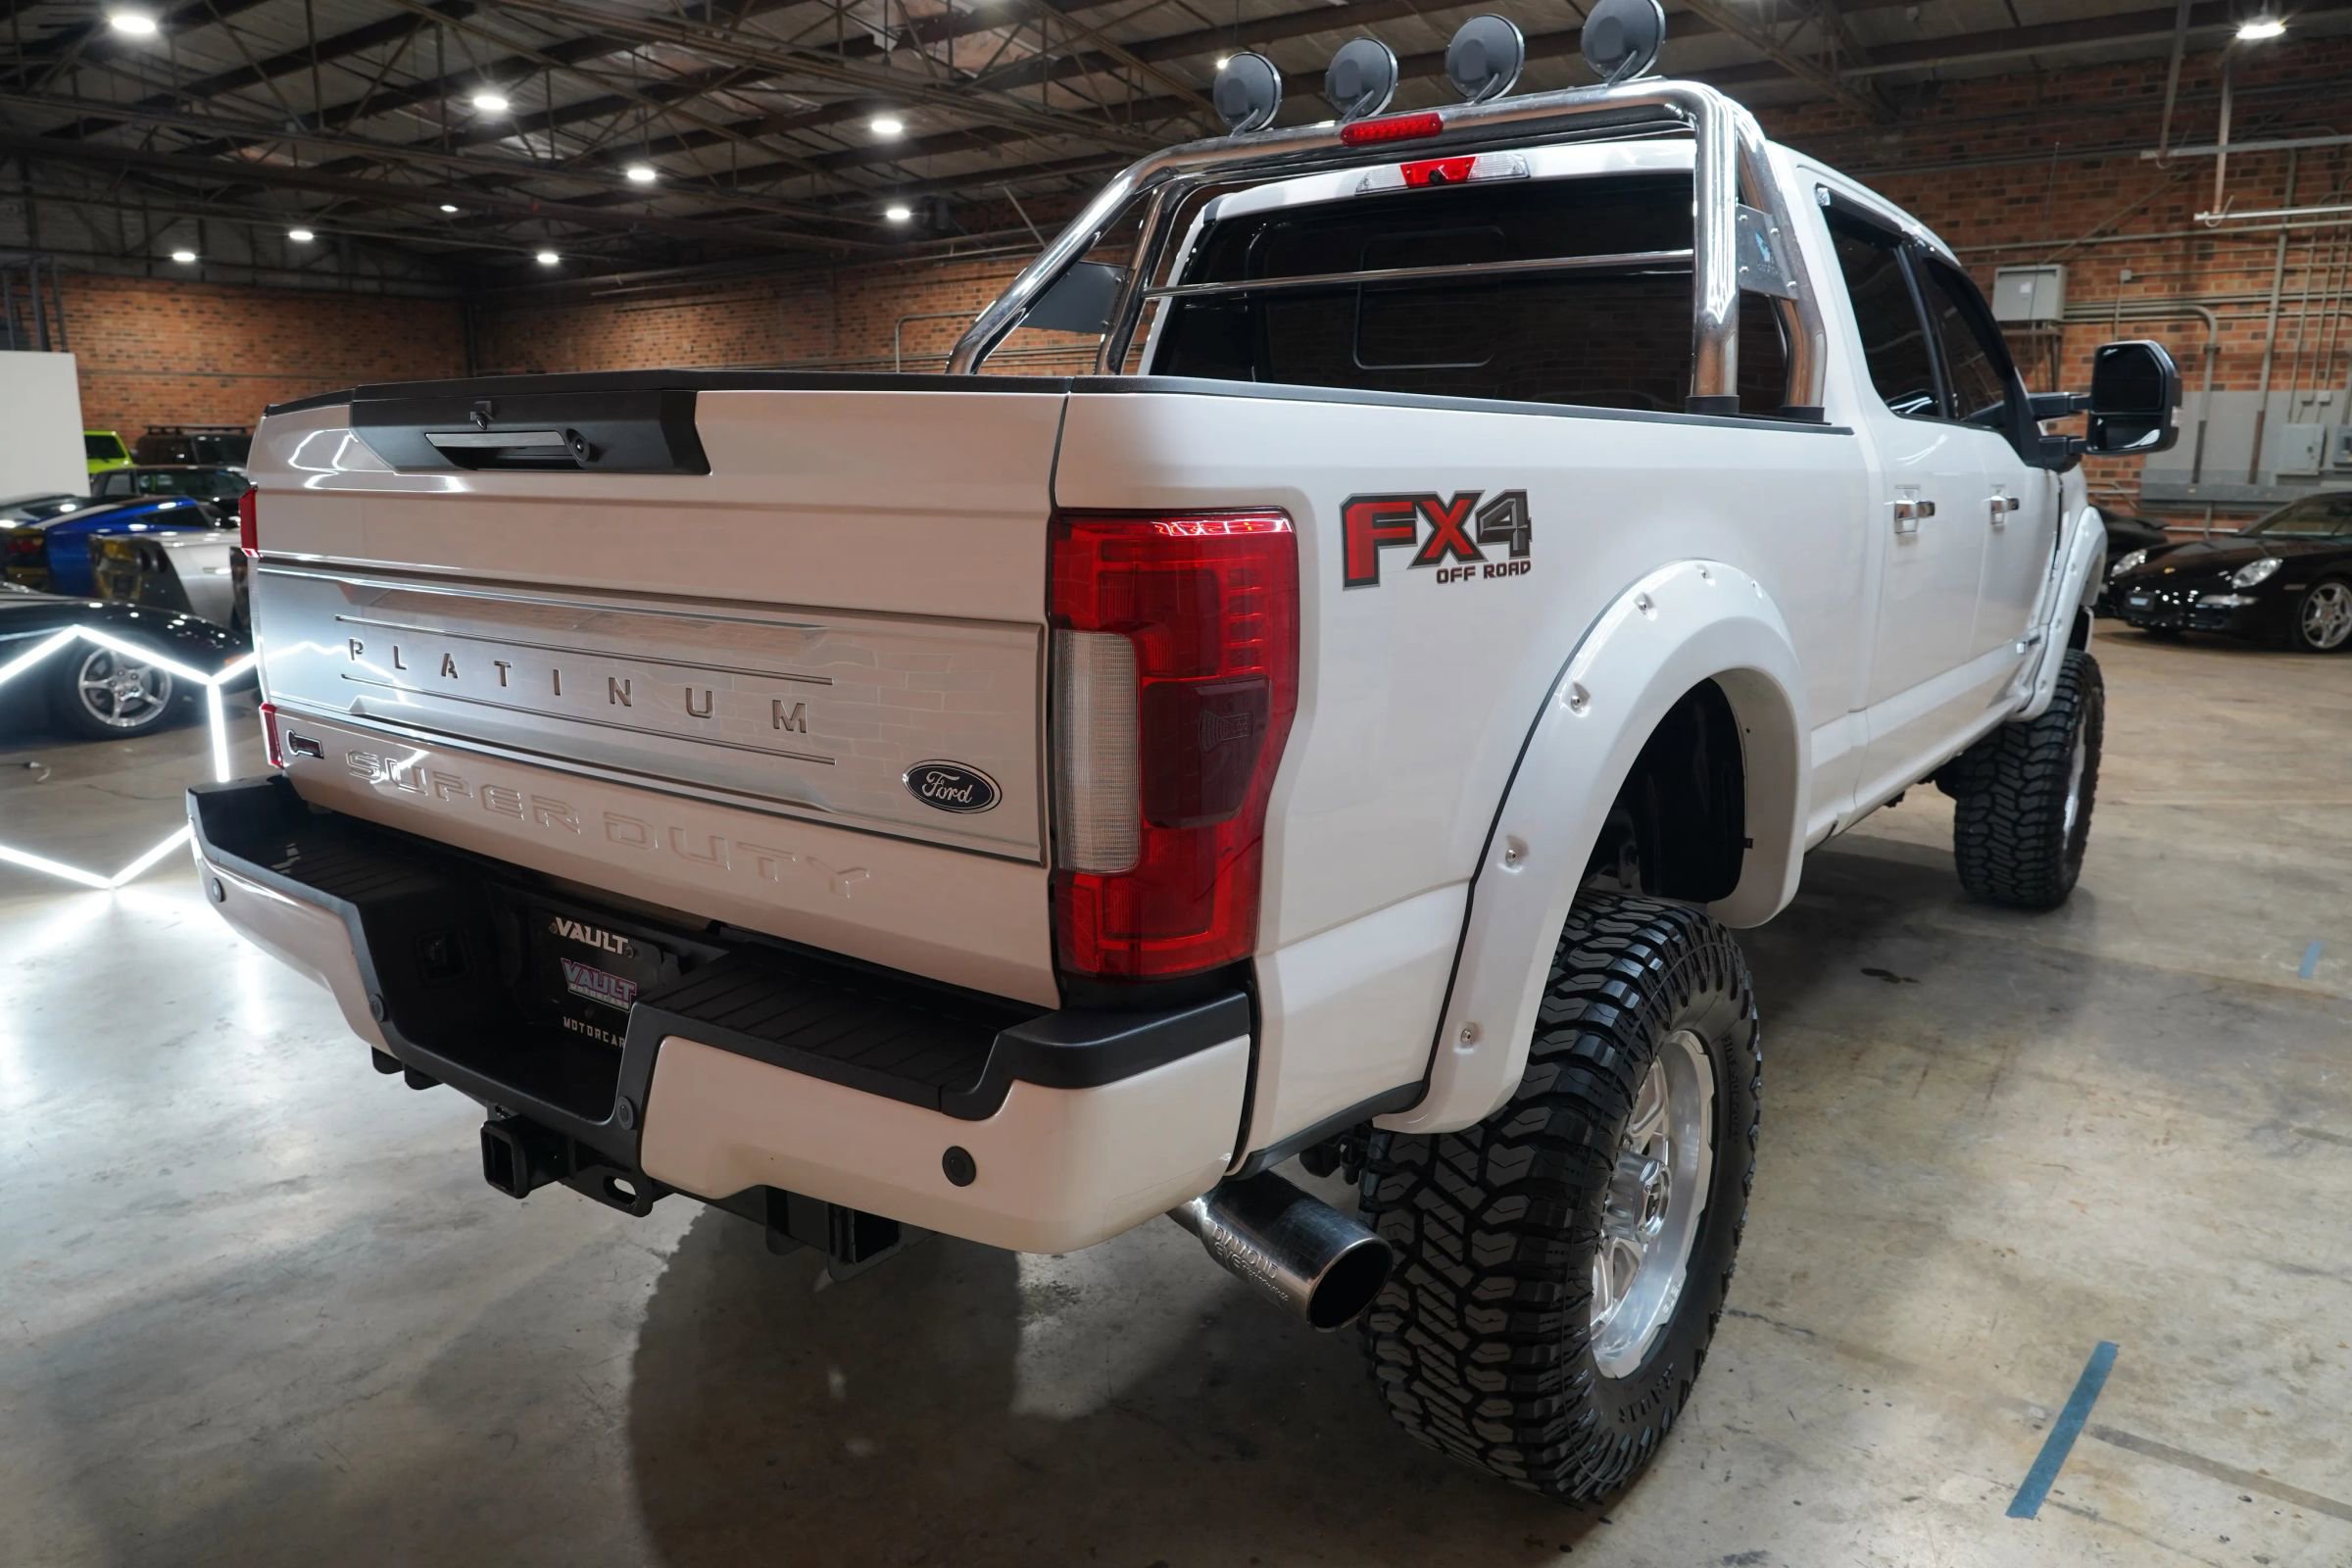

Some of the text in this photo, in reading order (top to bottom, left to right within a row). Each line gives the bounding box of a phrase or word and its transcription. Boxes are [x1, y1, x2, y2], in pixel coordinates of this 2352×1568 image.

[1340, 489, 1533, 591] FX4
[1436, 560, 1532, 585] OFF ROAD
[348, 636, 808, 734] PLATINUM
[921, 770, 974, 804] Ford
[345, 747, 870, 900] SUPER DUTY
[555, 916, 629, 956] VAULT
[563, 959, 635, 1003] VAULT
